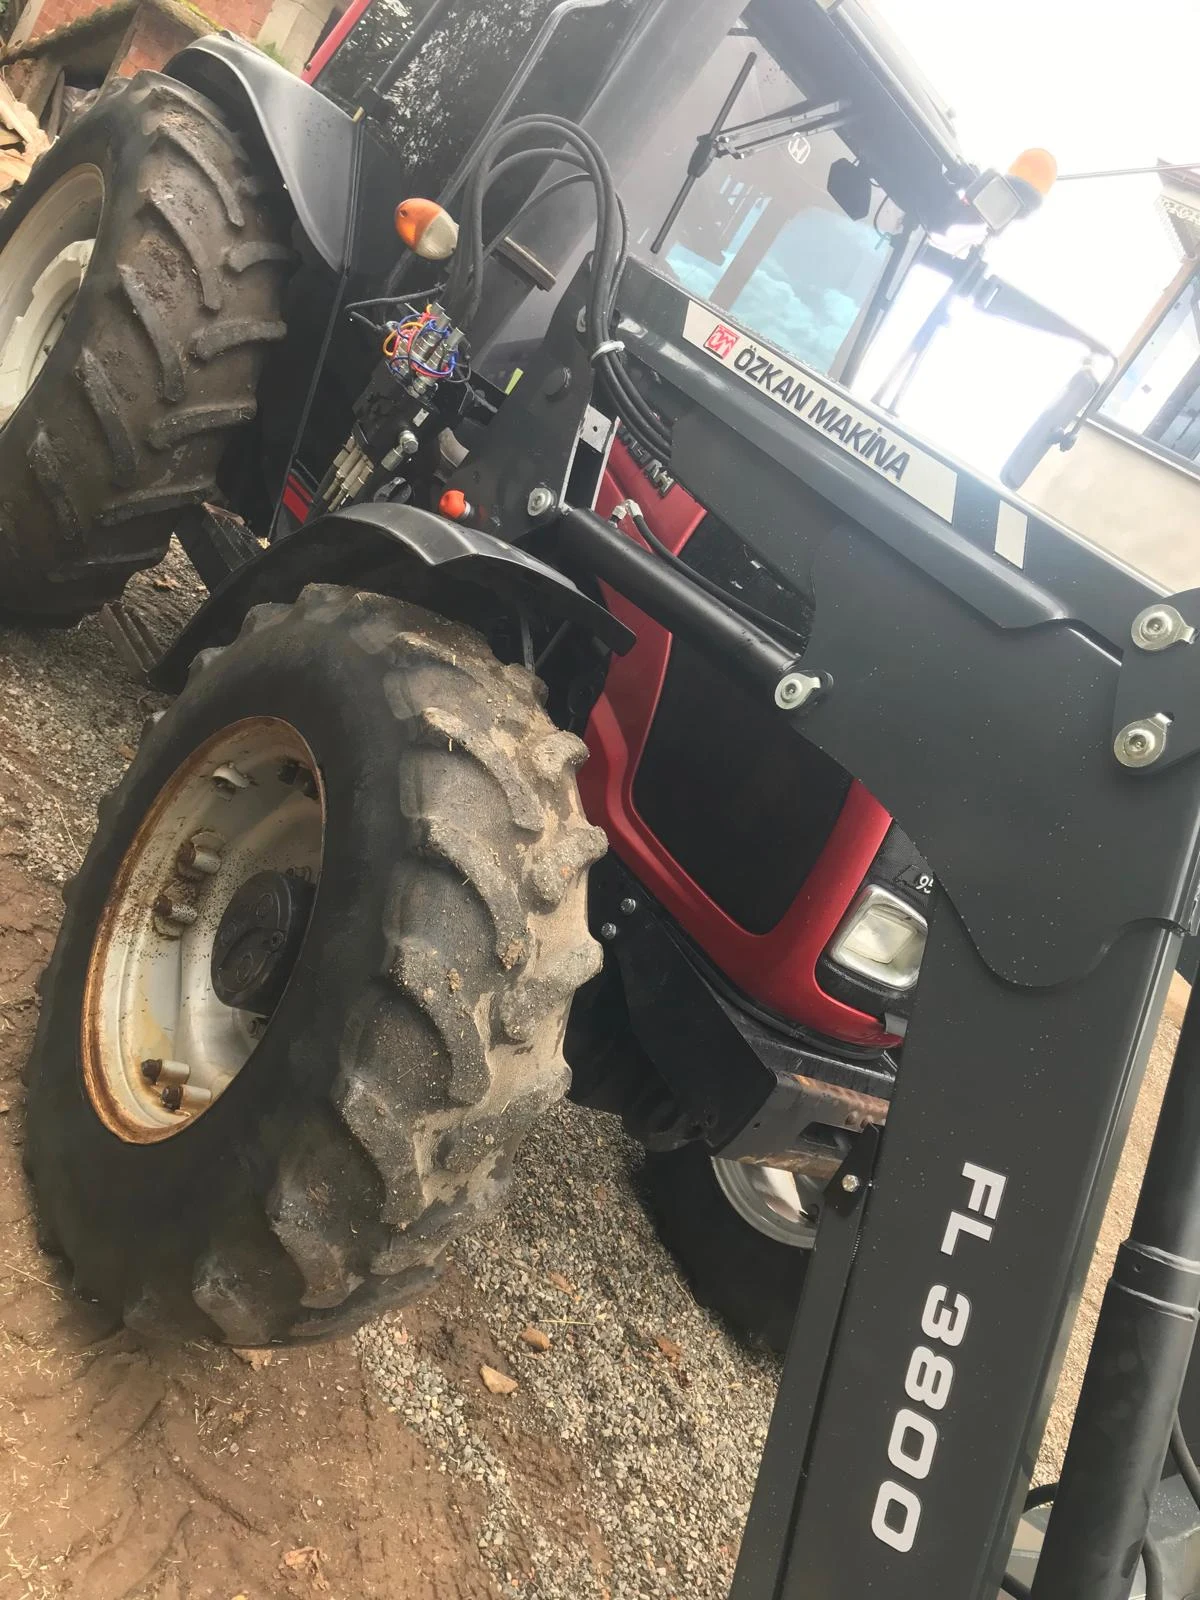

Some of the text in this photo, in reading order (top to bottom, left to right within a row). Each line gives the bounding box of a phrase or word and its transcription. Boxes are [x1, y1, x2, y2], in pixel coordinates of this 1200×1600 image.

[733, 345, 911, 482] ÖZKAN MAKİNA
[871, 1161, 1007, 1553] FL 3800
